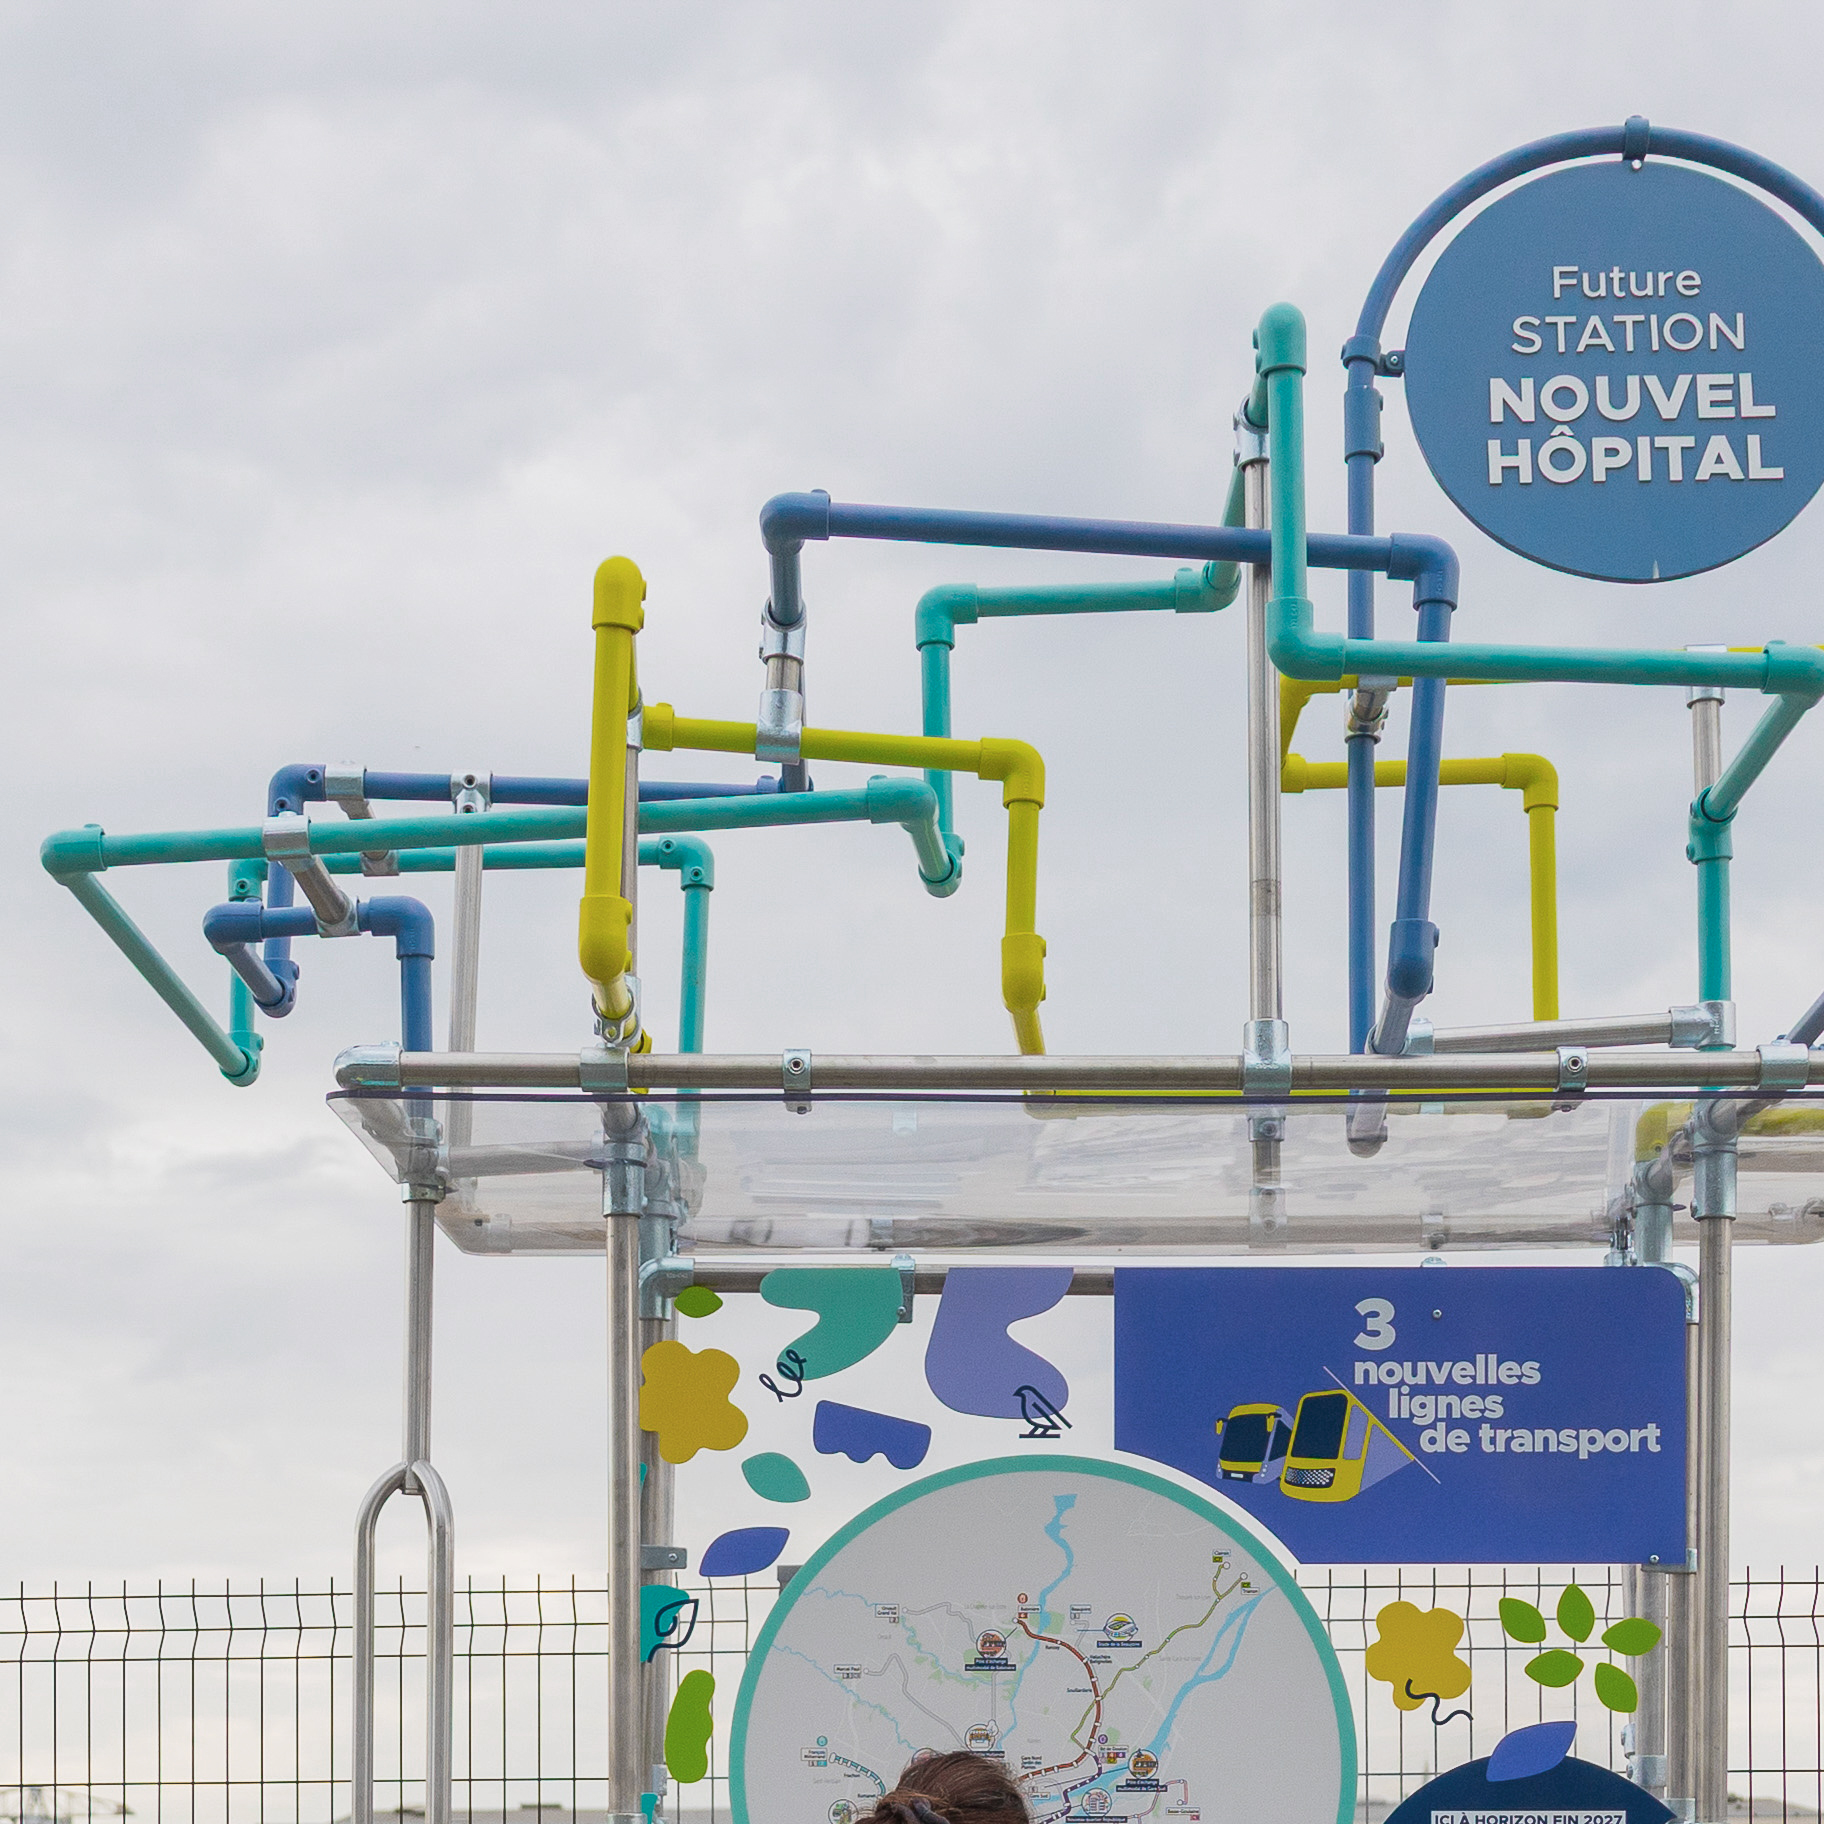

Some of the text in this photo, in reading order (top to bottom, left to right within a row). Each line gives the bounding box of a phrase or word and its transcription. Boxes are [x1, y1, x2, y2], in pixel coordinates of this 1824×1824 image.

[1552, 266, 1702, 298] Future
[1511, 312, 1746, 354] STATION
[1488, 372, 1777, 423] NOUVEL
[1487, 424, 1785, 485] HÔPITAL
[1353, 1298, 1396, 1351] 3
[1354, 1354, 1542, 1386] nouvelles
[1388, 1388, 1505, 1425] lignes
[1419, 1422, 1662, 1460] de transport
